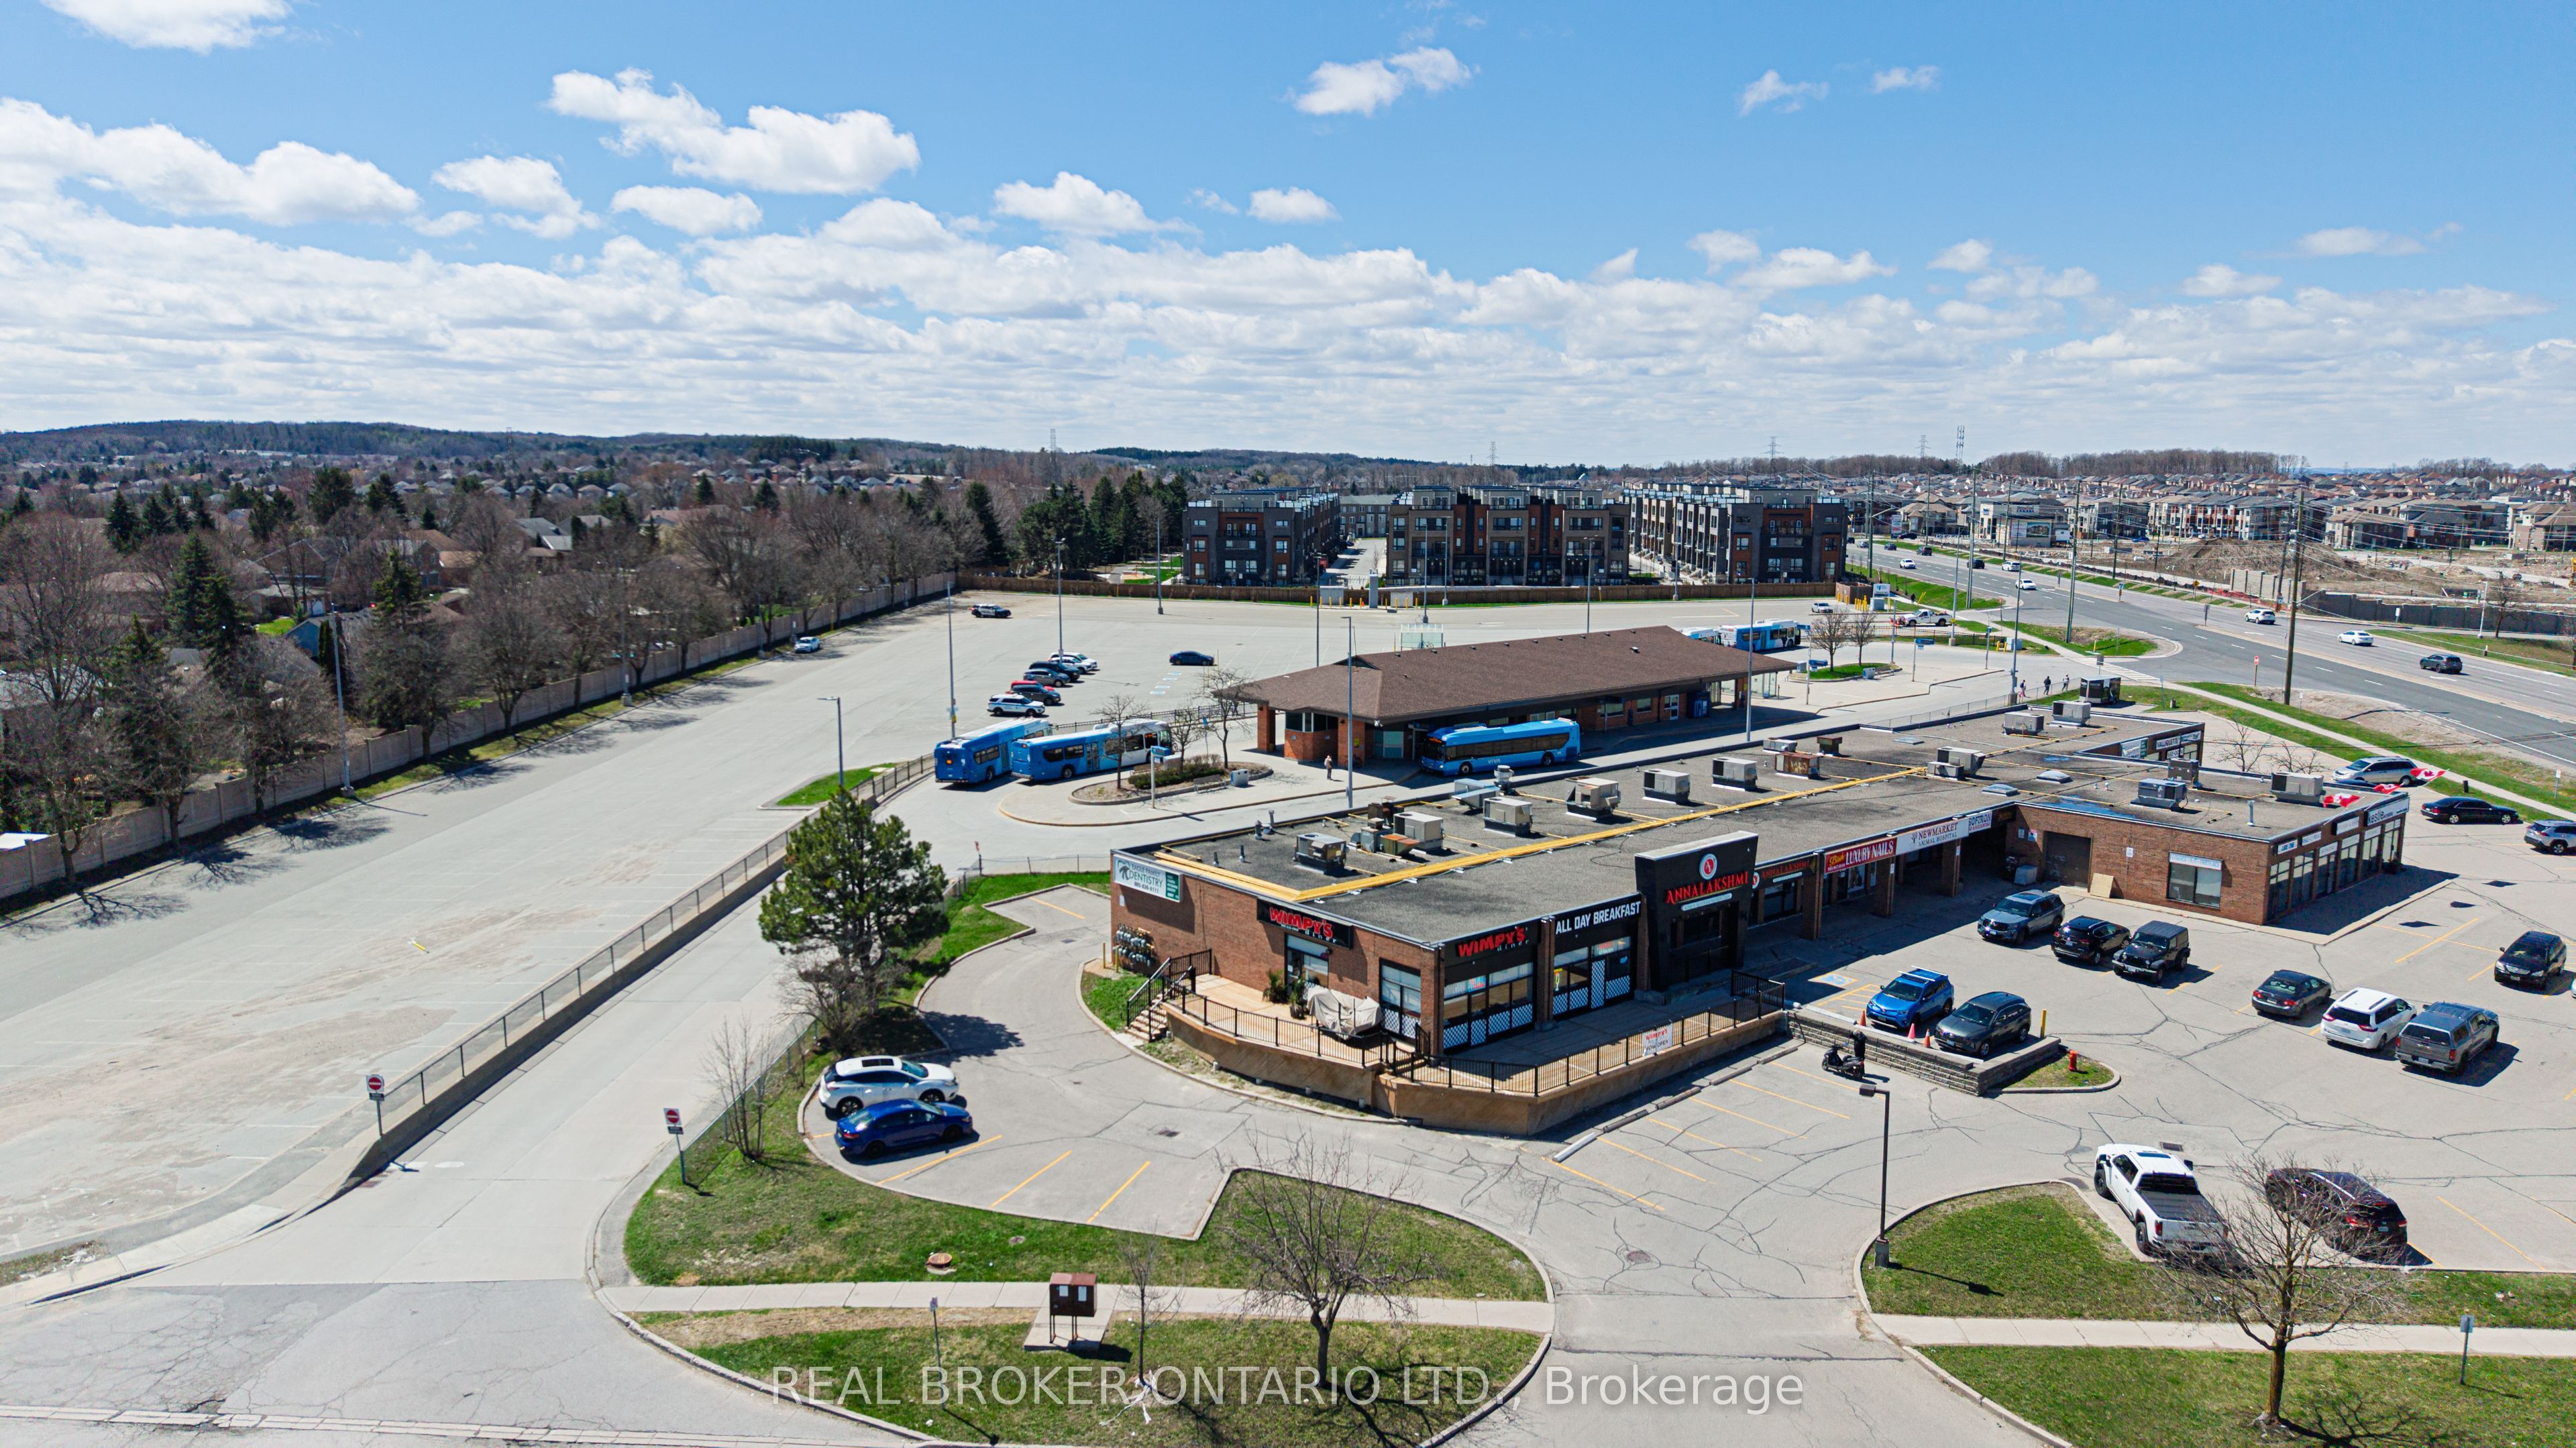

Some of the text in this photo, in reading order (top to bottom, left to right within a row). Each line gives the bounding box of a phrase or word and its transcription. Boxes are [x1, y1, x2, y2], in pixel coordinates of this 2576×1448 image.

[1919, 822, 1958, 840] NEWMARKET
[1919, 832, 1957, 846] ANIMAL HOSPITAL
[1845, 846, 1871, 865] LUXURY
[1872, 840, 1894, 858] NAILS
[1129, 870, 1163, 887] DENTISTRY
[1761, 860, 1810, 879] ANNALAKSHMI
[1666, 871, 1749, 904] ANNALAKSHMI
[1269, 906, 1334, 939] WIMPY'S
[1556, 901, 1642, 934] ALL DAY BREAKFAST
[1305, 928, 1337, 944] diner
[1457, 926, 1526, 957] WIMPY'S
[1497, 939, 1529, 952] diner
[1657, 1040, 1668, 1048] OPEN
